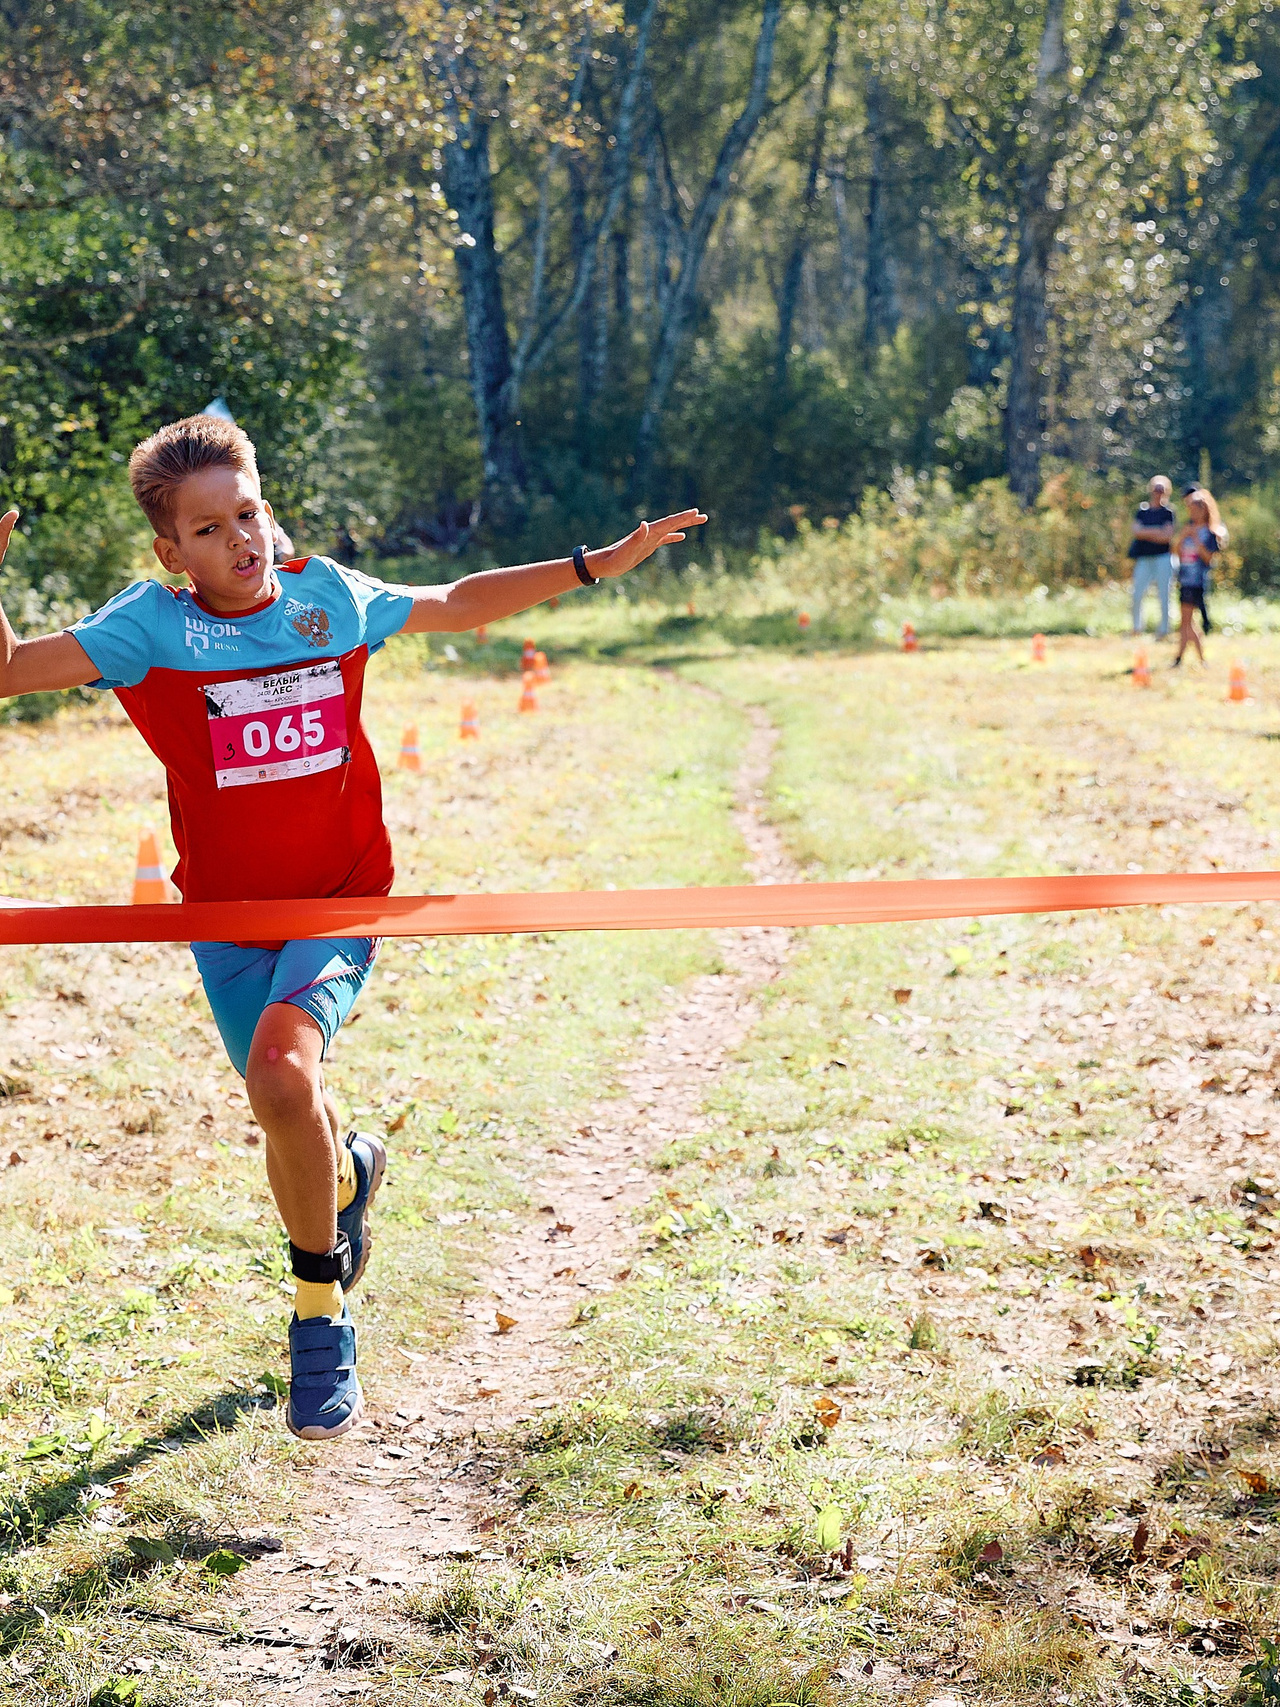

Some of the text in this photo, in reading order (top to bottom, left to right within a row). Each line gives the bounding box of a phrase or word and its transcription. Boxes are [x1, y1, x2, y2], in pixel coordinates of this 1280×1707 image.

[262, 674, 300, 689] БЕЛЫЙ
[272, 685, 293, 696] ЛЕС
[242, 709, 326, 758] 065
